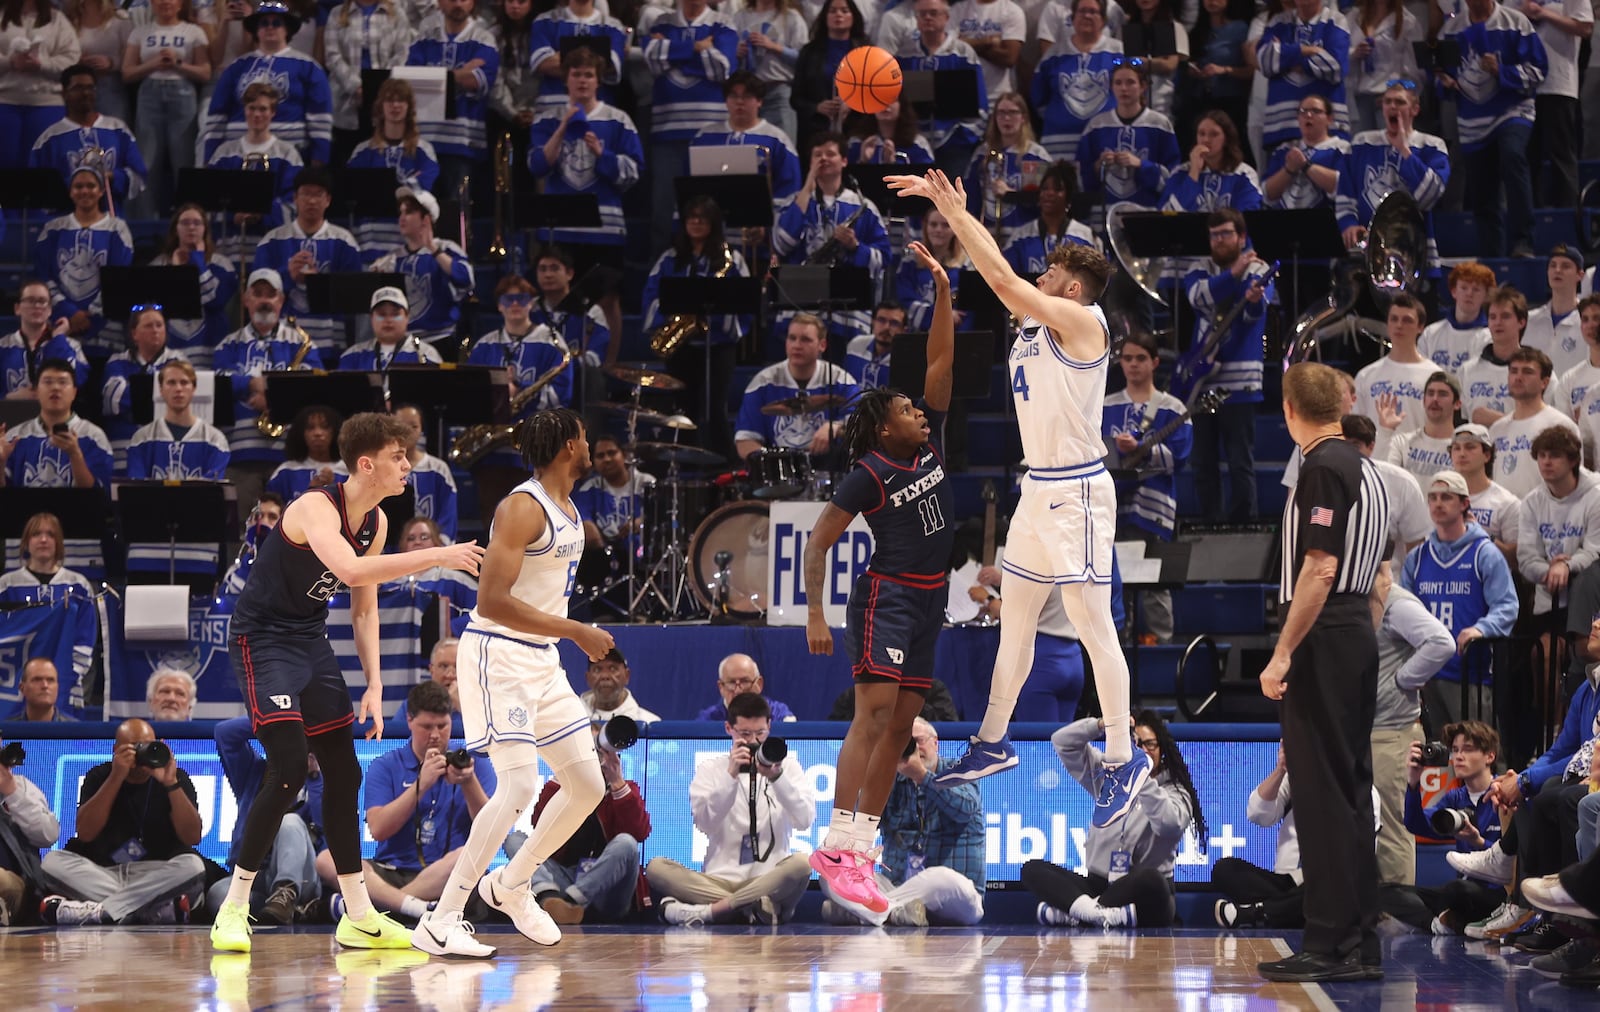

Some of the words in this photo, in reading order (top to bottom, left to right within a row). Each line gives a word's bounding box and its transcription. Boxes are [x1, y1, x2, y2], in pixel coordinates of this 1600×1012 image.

[146, 35, 185, 47] SLU
[1013, 365, 1030, 401] 4
[889, 464, 945, 508] FLYERS
[918, 493, 945, 537] 11
[1419, 581, 1444, 595] SAINT
[1445, 581, 1471, 595] LOUIS
[1420, 768, 1441, 792] G
